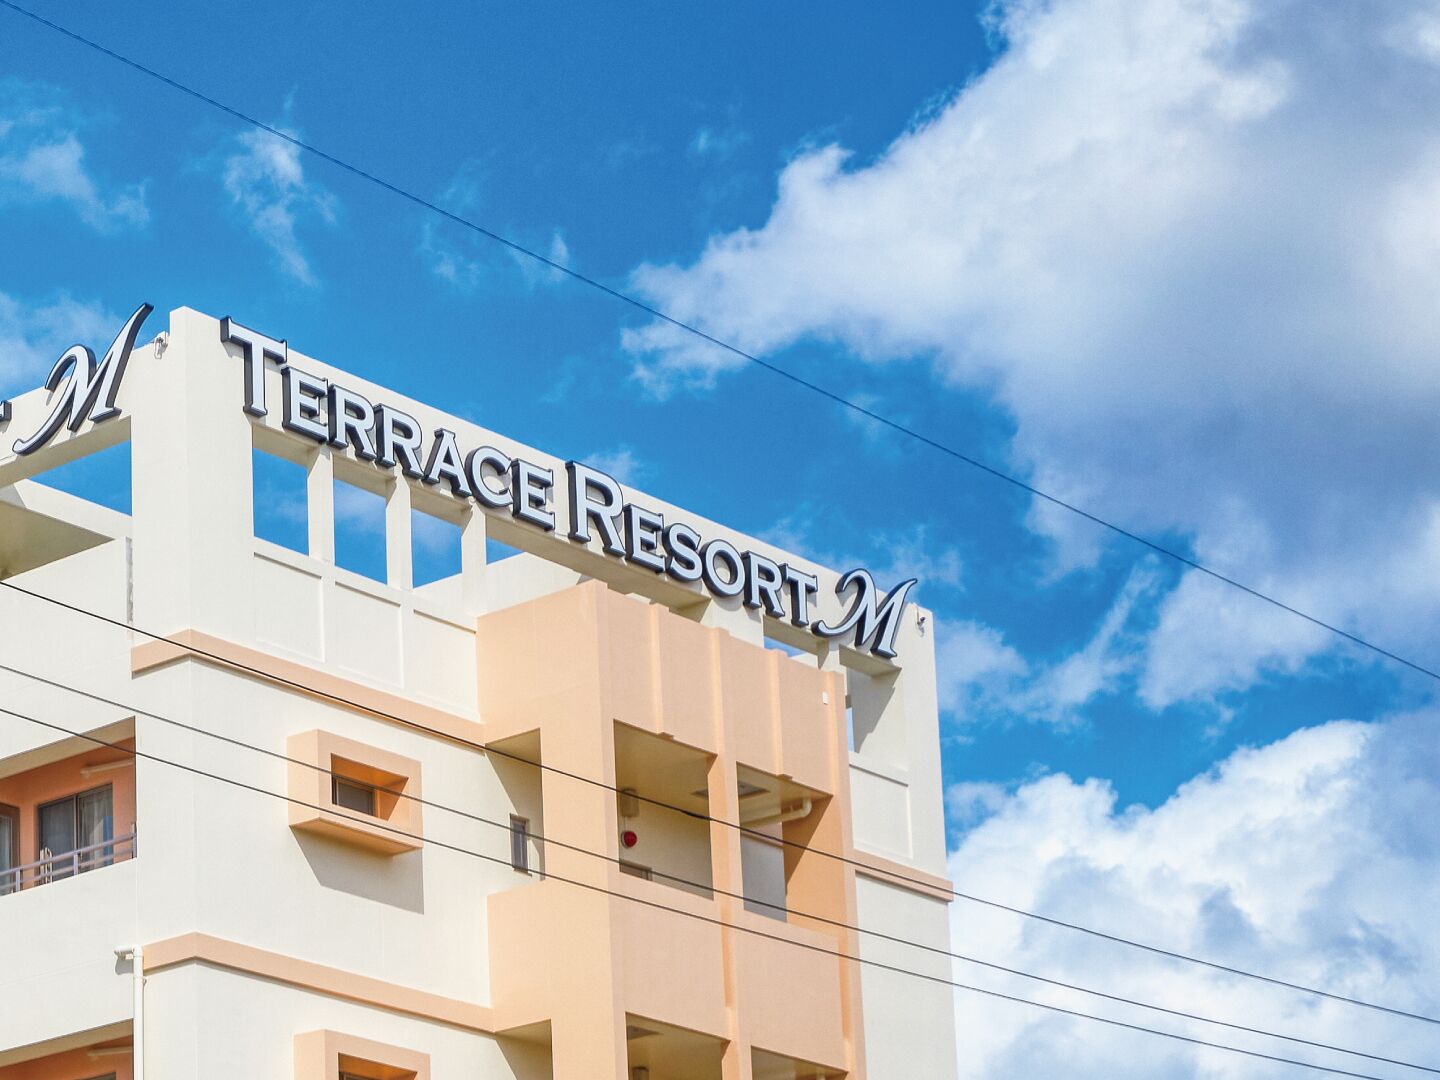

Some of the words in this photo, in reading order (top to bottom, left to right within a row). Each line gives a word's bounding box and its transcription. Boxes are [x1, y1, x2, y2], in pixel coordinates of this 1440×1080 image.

[12, 302, 155, 456] M
[220, 315, 556, 531] TERRACE
[565, 460, 818, 627] RESORT
[811, 567, 918, 658] M
